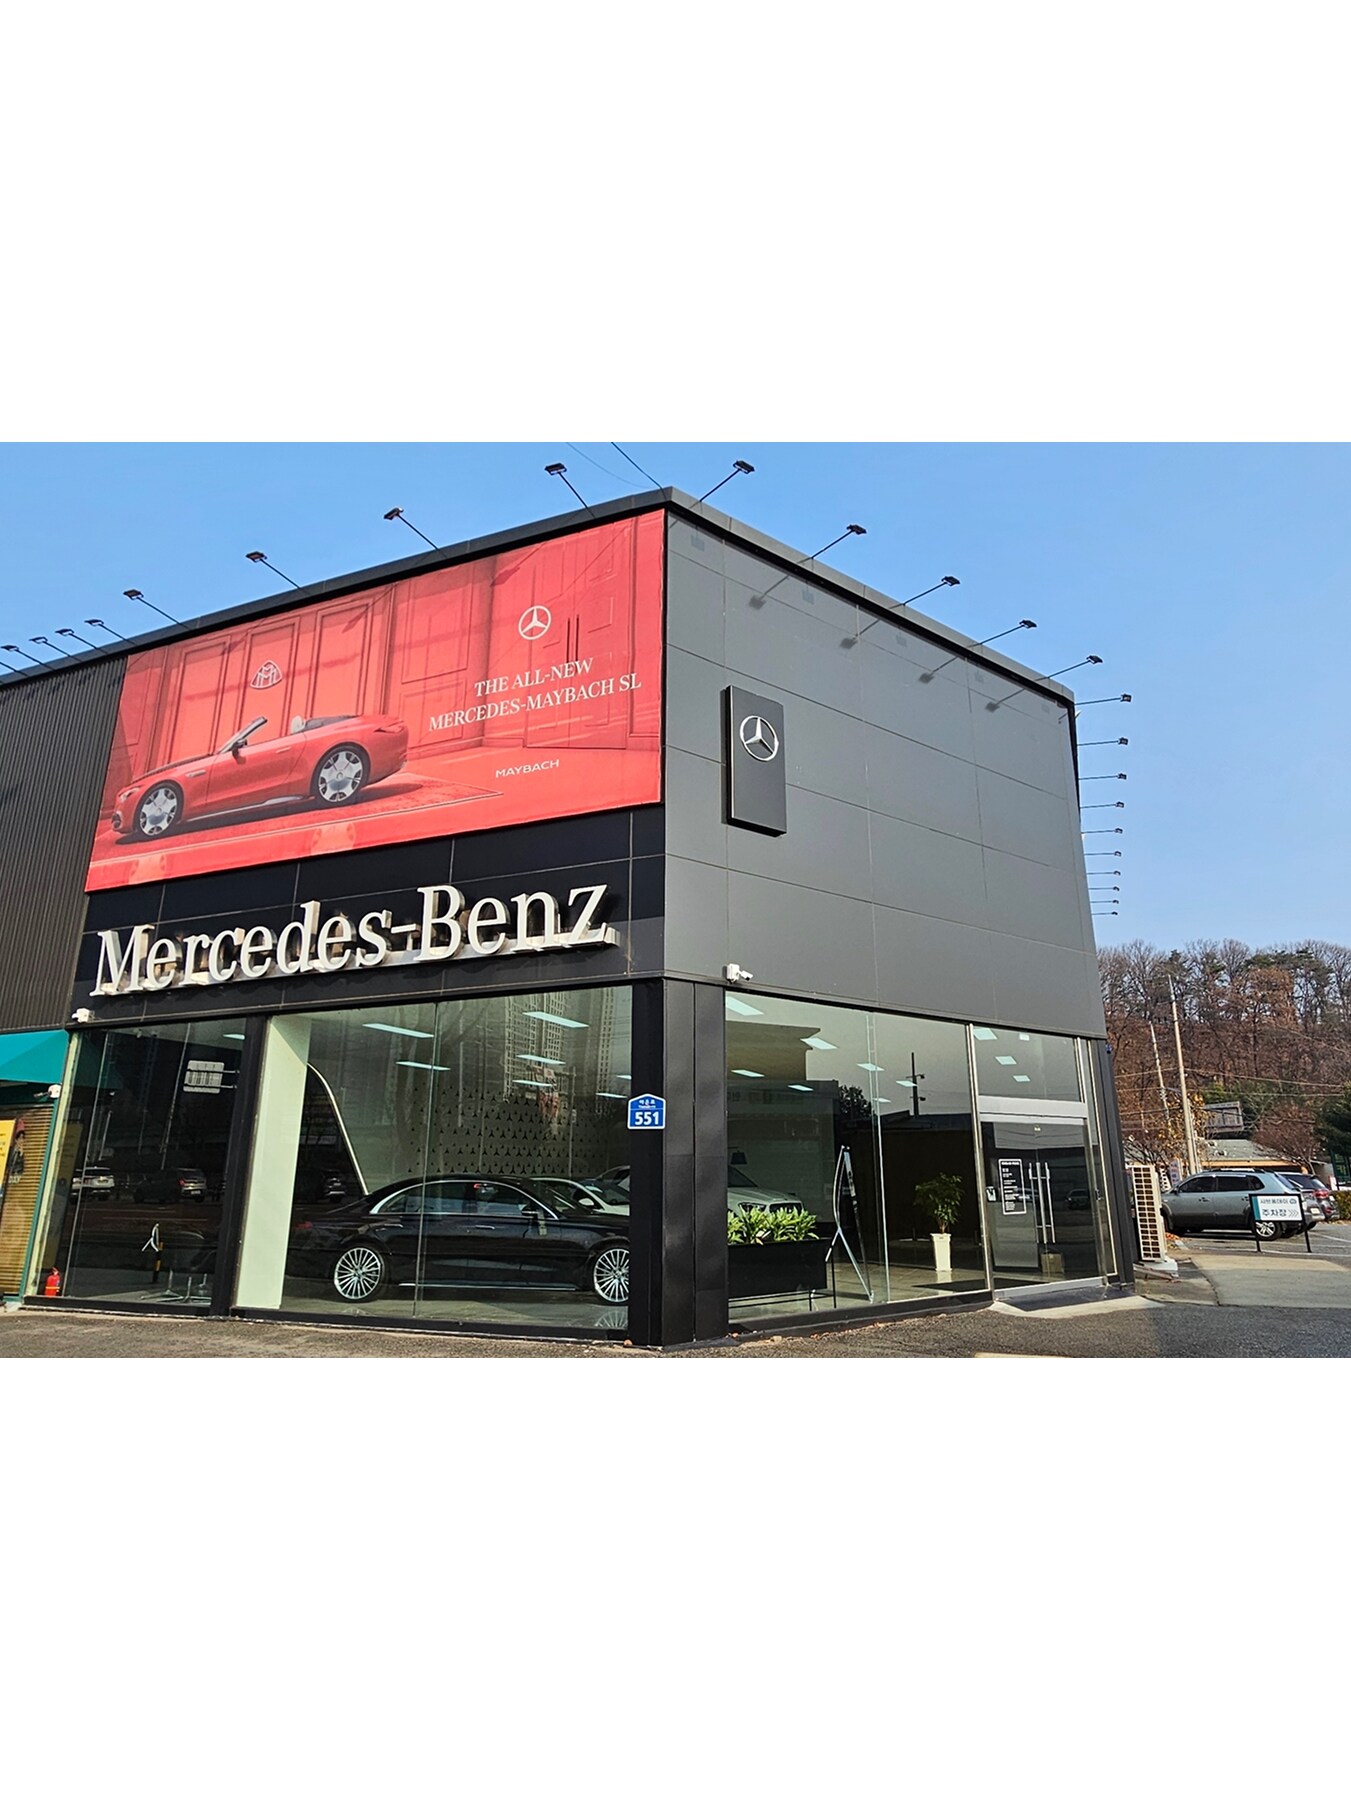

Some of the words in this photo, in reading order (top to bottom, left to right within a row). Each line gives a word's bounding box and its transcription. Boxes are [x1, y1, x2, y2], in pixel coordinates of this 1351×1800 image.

[474, 677, 508, 697] THE
[512, 657, 593, 689] ALL-NEW
[428, 679, 614, 731] MERCEDES-MAYBACH
[619, 673, 642, 691] SL
[495, 759, 560, 778] MAYBACH
[89, 884, 612, 997] Mercedes-Benz
[634, 1111, 659, 1125] 551
[1262, 1208, 1287, 1217] 주차장
